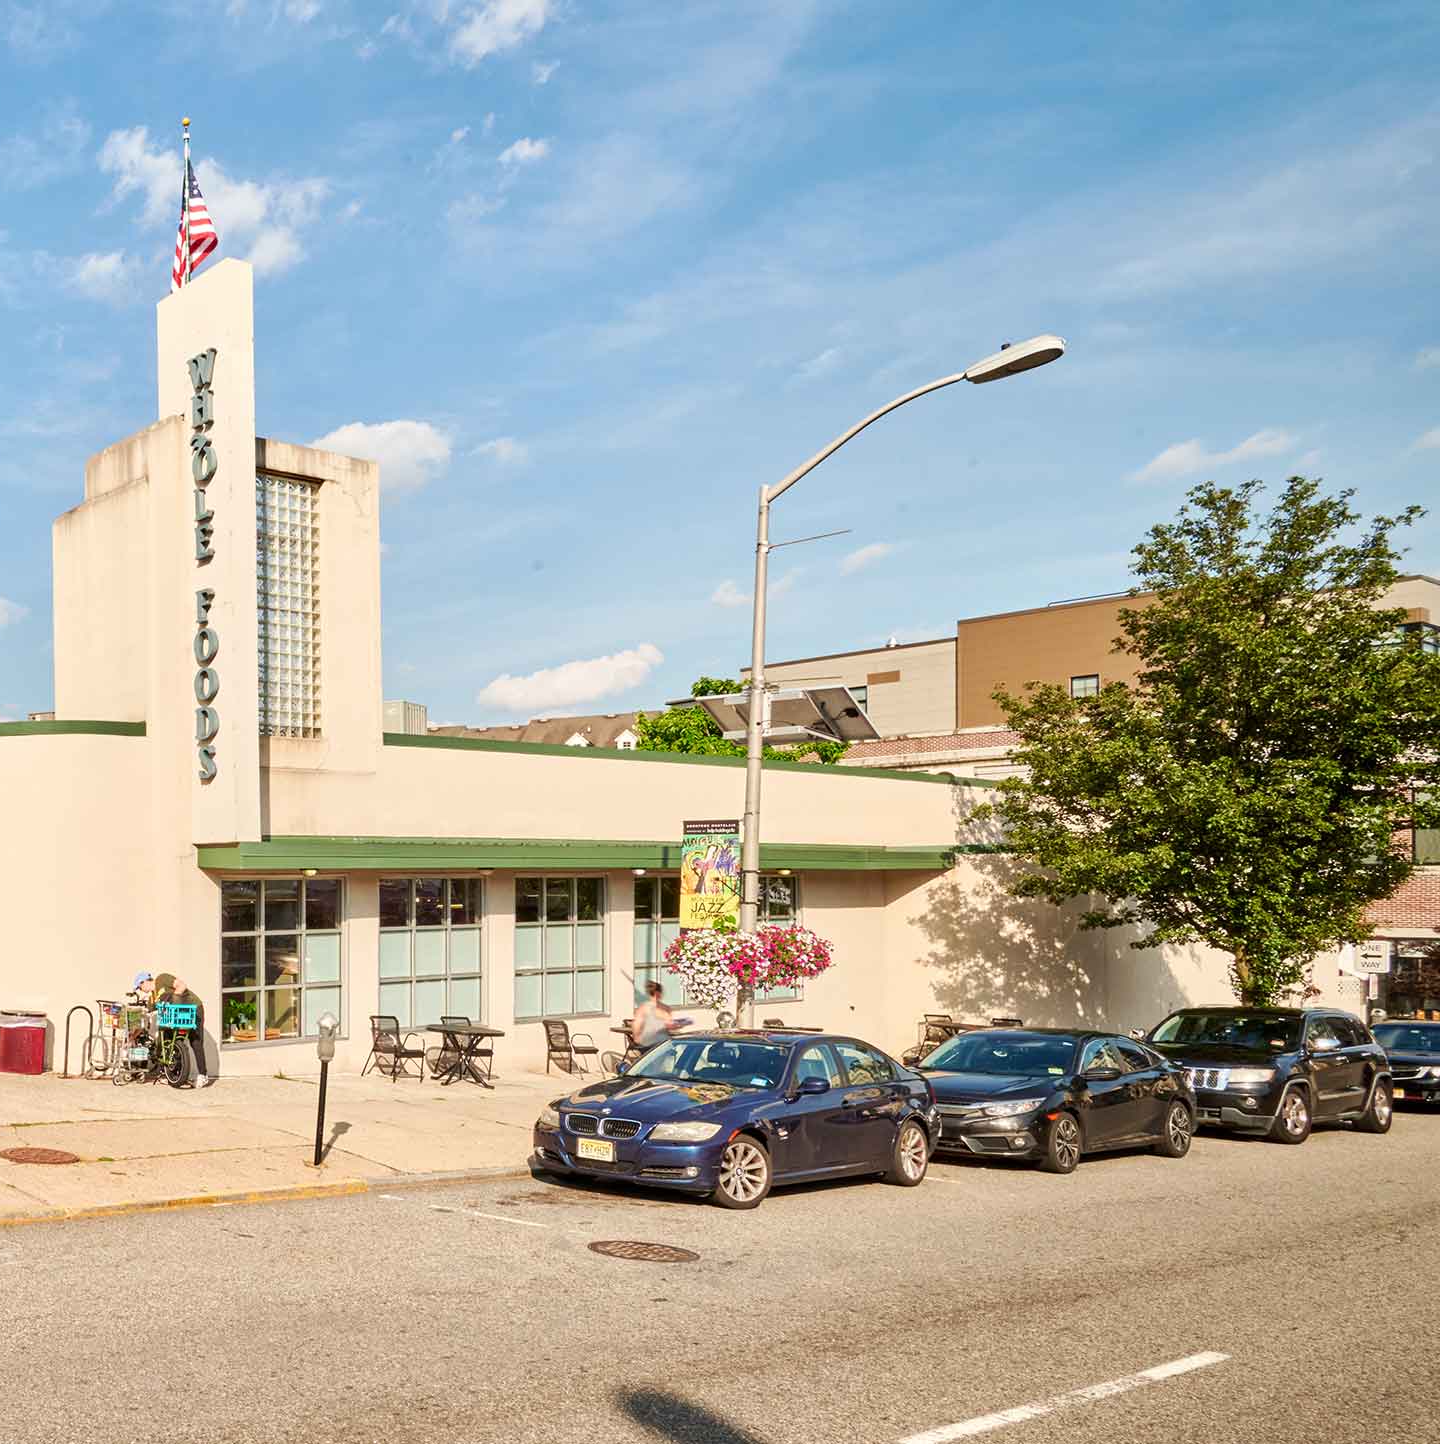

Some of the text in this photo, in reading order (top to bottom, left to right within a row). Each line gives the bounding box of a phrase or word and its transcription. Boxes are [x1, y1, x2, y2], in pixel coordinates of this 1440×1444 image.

[187, 348, 220, 783] WHOLE FOODS
[691, 902, 725, 914] JAZZ
[1360, 944, 1382, 952] ONE
[1361, 961, 1380, 969] WAY
